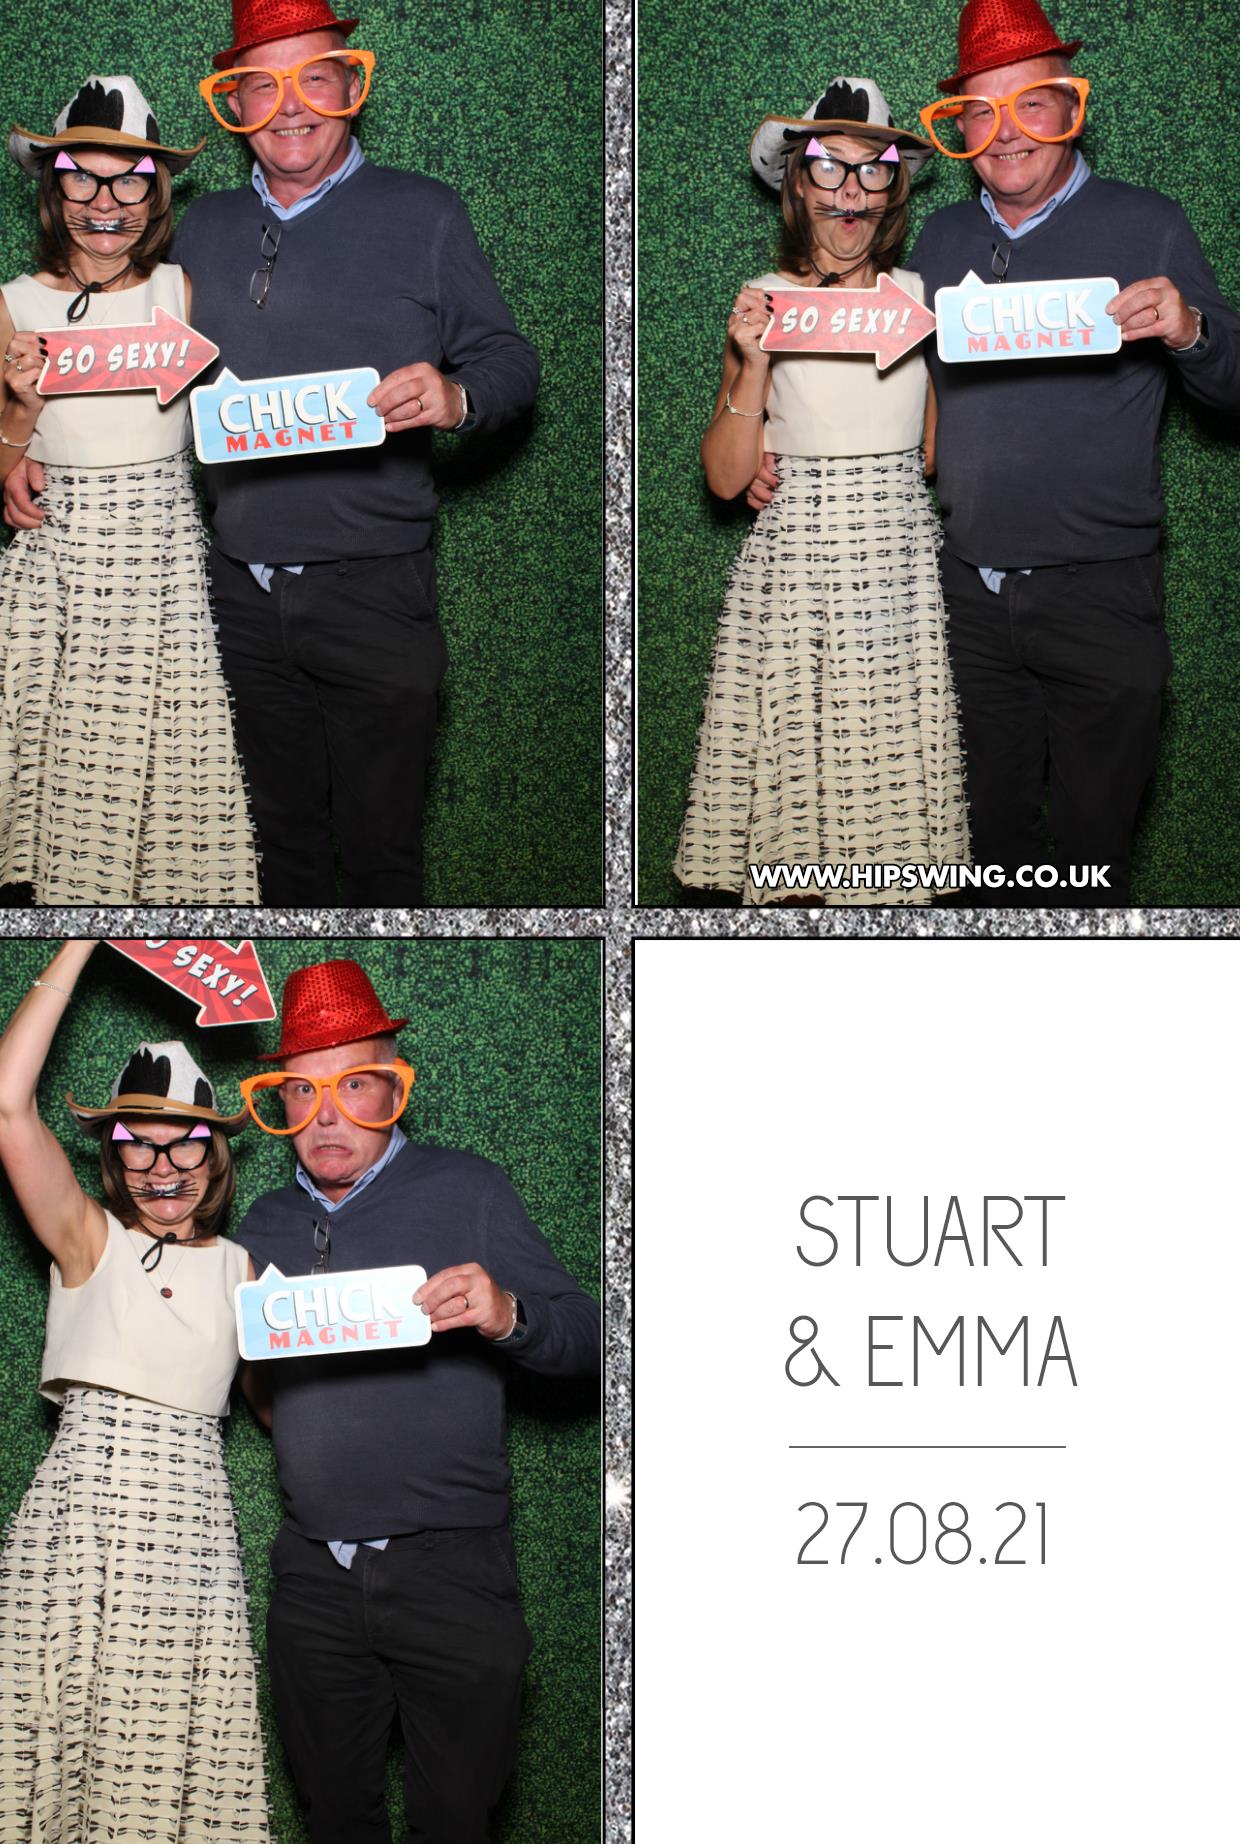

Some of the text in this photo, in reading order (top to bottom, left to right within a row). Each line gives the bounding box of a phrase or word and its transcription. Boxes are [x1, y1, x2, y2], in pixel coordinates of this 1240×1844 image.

[782, 306, 914, 336] SO SEXY!
[962, 289, 1095, 335] CHICK
[57, 339, 191, 375] SO SEXY!
[968, 329, 1095, 354] MAGNET
[218, 380, 358, 435] CHICK
[226, 421, 358, 453] MAGNET
[172, 945, 258, 1007] SEXY!
[262, 1281, 403, 1331] CHICK
[269, 1320, 403, 1350] MAGNET
